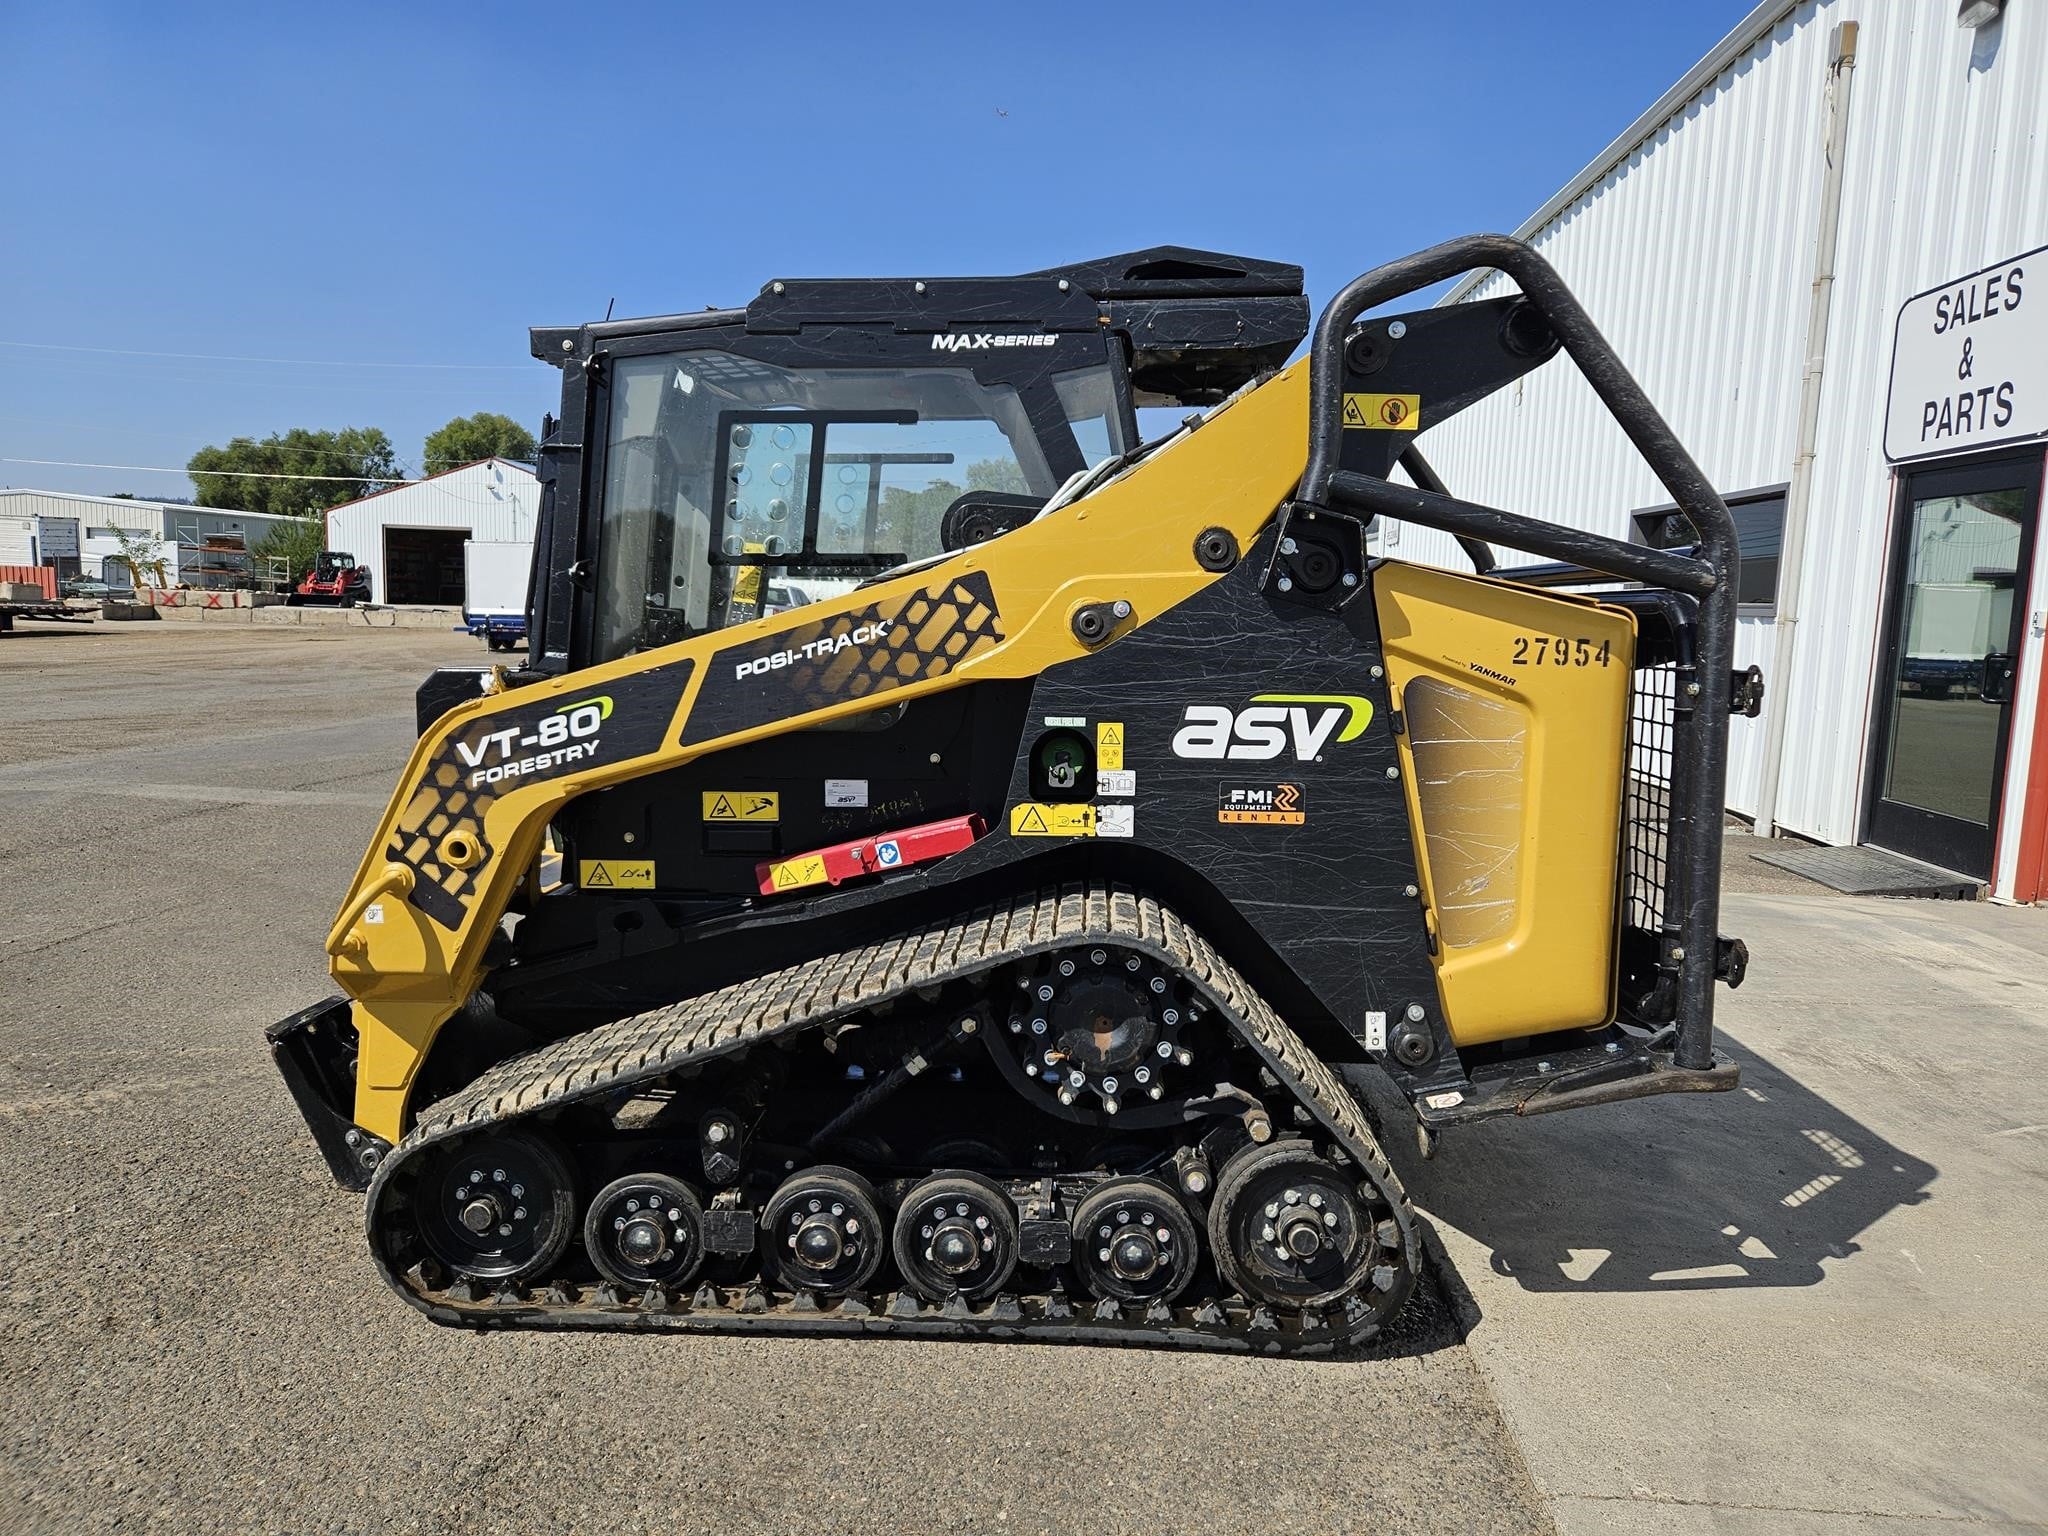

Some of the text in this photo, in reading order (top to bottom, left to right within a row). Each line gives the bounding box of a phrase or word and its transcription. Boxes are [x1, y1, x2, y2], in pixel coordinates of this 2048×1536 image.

[1933, 267, 2024, 335] SALES
[931, 334, 1056, 352] MAX-SERIES
[1958, 336, 1974, 380] &
[1921, 381, 2014, 441] PARTS
[1512, 637, 1611, 668] 27954
[1469, 661, 1517, 686] YANMAR
[456, 705, 601, 768] VT-80
[472, 739, 600, 788] FORESTRY
[1231, 789, 1273, 804] FMI
[1223, 813, 1300, 822] RENTAL
